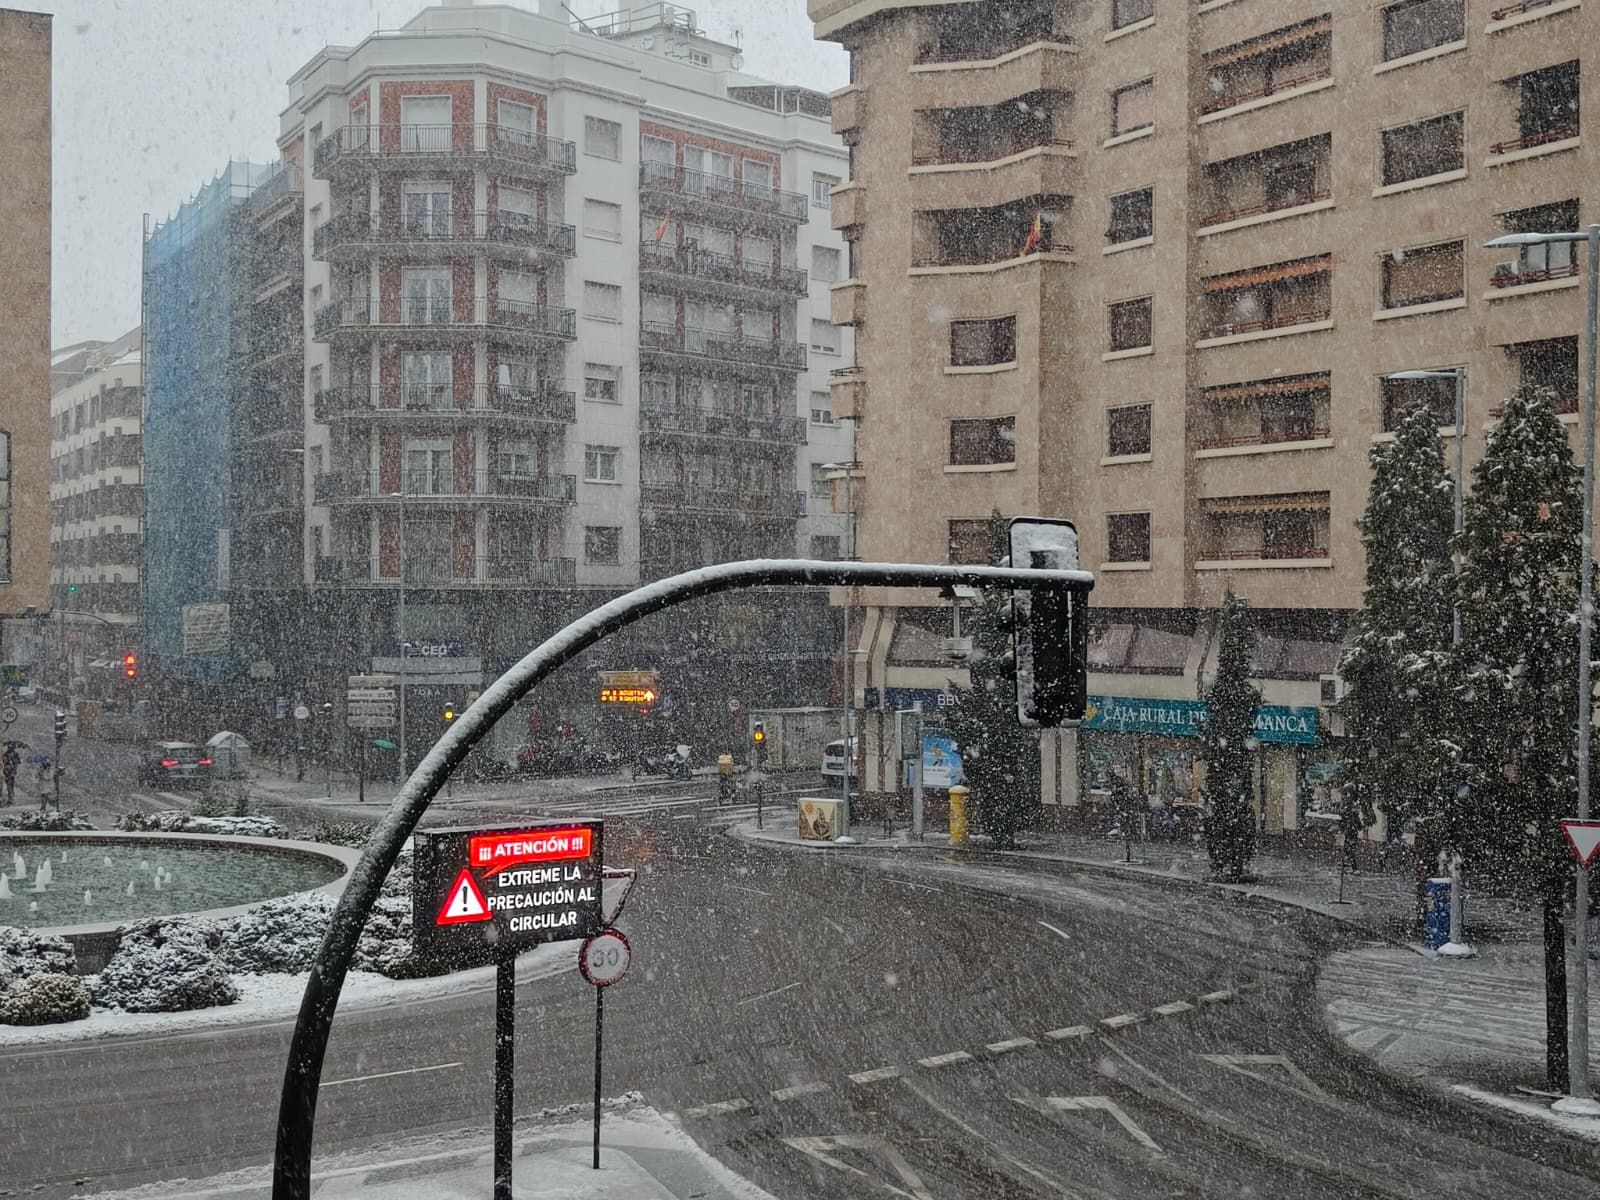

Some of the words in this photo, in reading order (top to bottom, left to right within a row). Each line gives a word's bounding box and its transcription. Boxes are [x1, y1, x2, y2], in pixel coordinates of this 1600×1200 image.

[1140, 707, 1184, 724] RURAL
[494, 837, 569, 857] ATENCIÓN
[572, 837, 583, 850] !!!
[498, 868, 561, 887] EXTREME
[564, 866, 581, 881] LA
[487, 887, 574, 911] PRECAUCIÓN
[578, 887, 595, 902] AL
[510, 911, 577, 932] CIRCULAR
[592, 948, 619, 967] 30
